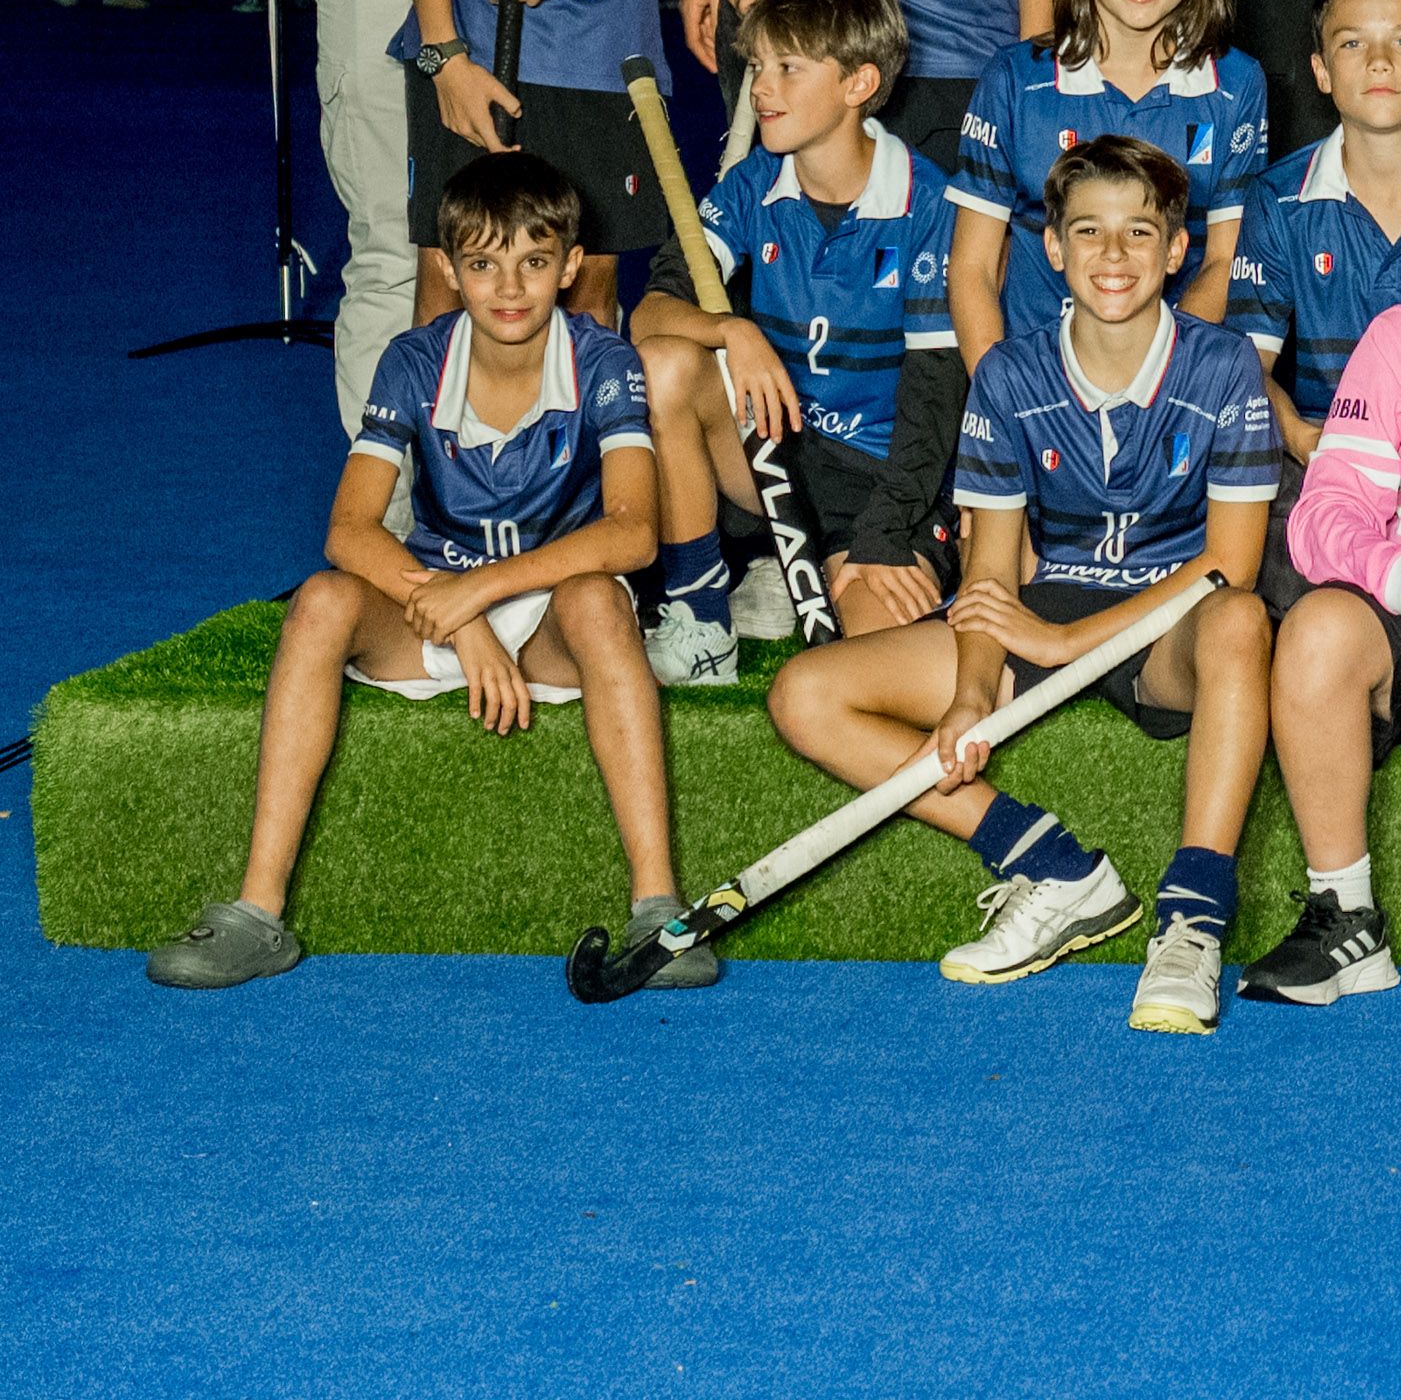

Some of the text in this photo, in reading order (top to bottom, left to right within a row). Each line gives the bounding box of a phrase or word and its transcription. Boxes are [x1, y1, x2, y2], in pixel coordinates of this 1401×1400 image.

[807, 315, 830, 376] 2
[480, 519, 520, 557] 10
[750, 436, 838, 645] VLACK
